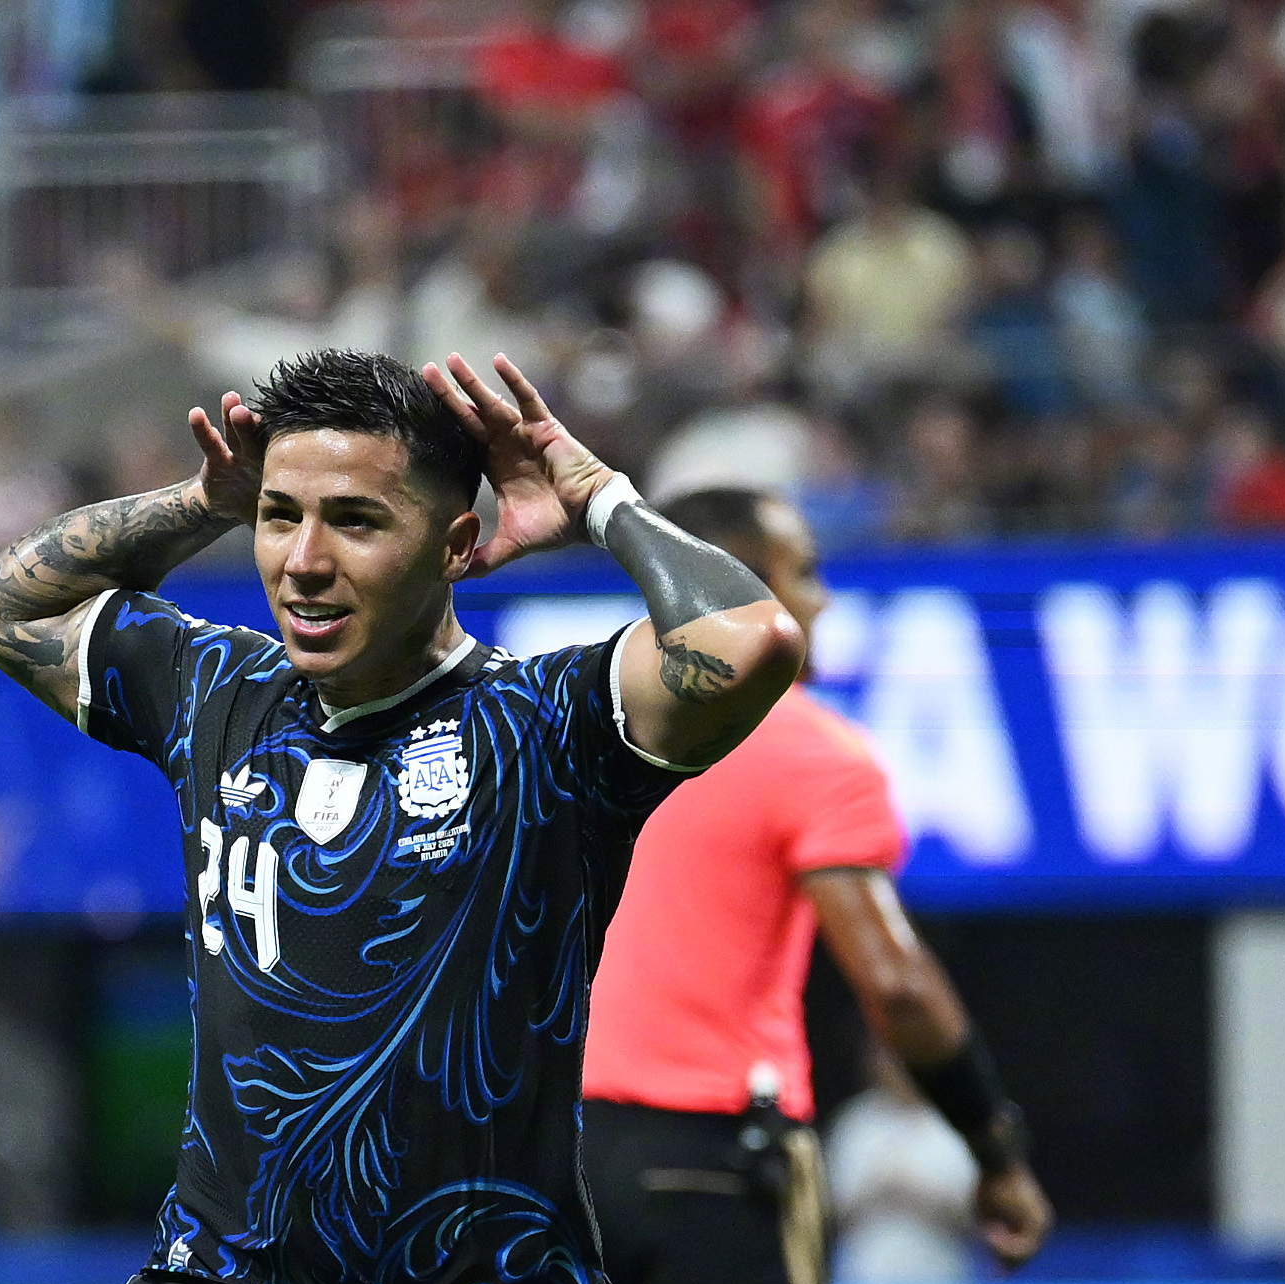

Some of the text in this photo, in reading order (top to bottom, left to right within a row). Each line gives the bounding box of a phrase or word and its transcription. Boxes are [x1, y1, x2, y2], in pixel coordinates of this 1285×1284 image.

[414, 756, 453, 791] AFA
[313, 811, 339, 821] FIFA
[398, 834, 426, 847] ENGLAND
[437, 824, 469, 839] ARGENTINA
[414, 838, 455, 852] 15 JULY 2026
[421, 849, 448, 861] ATLANTA
[198, 816, 281, 973] 24
